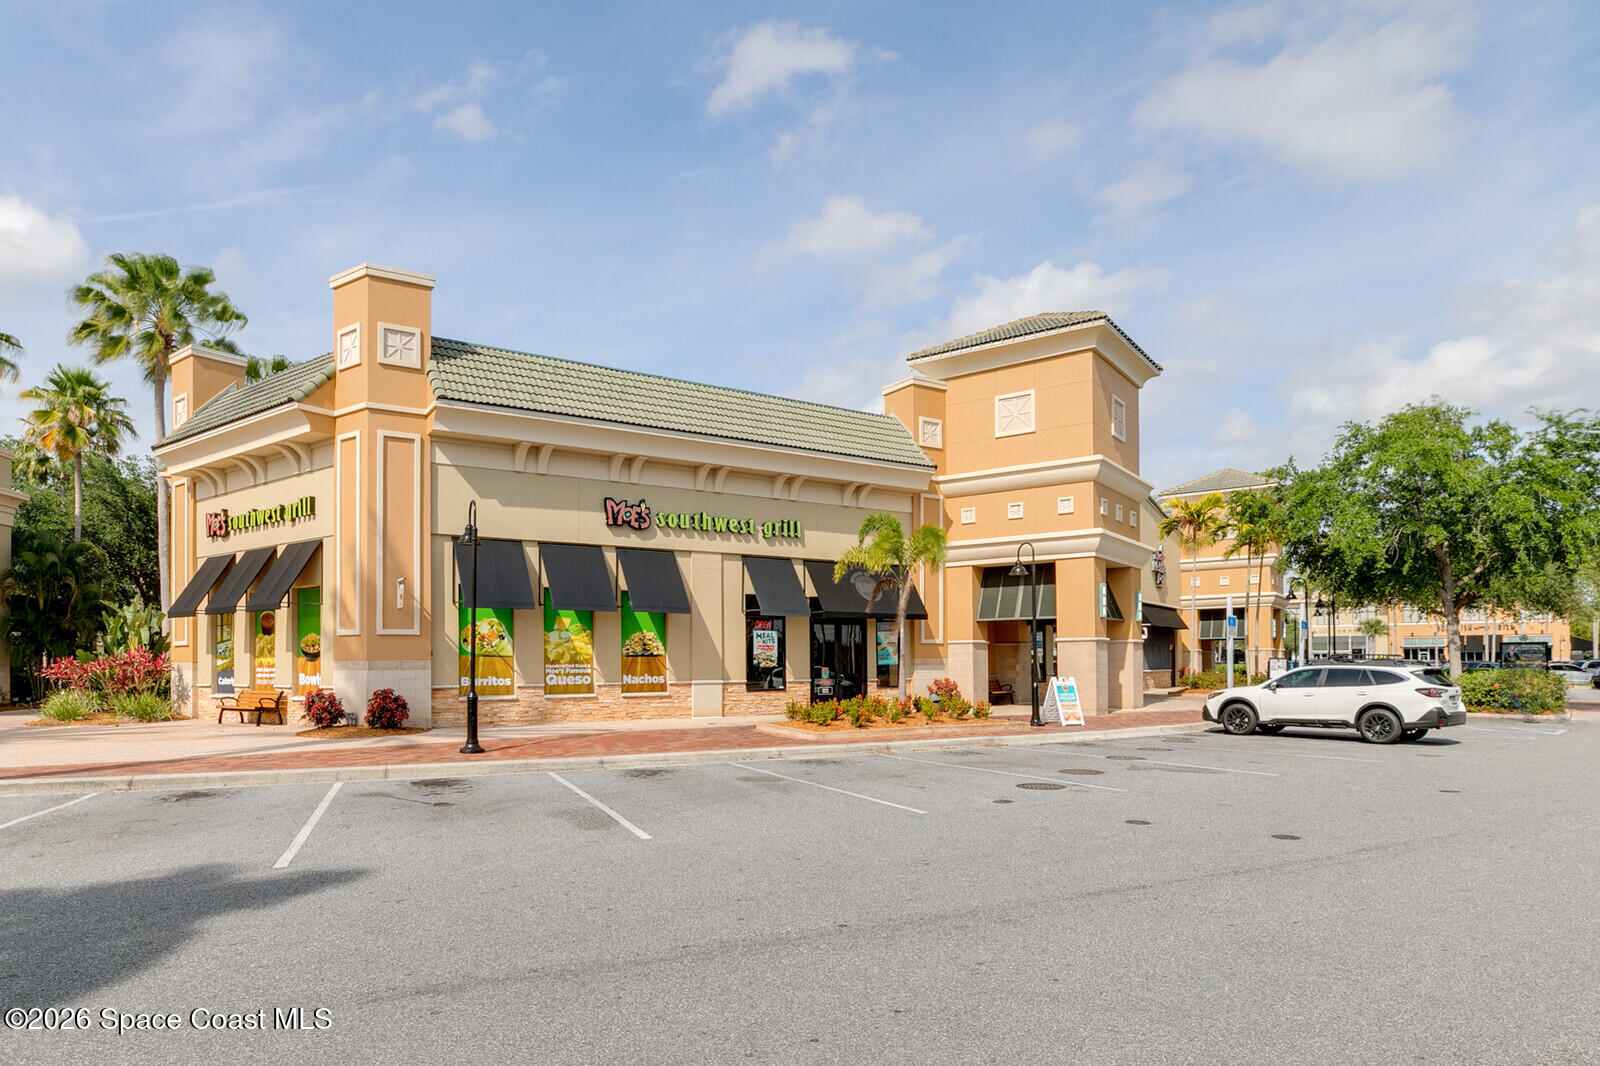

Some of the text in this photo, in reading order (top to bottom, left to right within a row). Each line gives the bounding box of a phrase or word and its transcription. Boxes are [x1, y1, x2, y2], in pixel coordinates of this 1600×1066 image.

[228, 504, 284, 531] southwest
[285, 496, 315, 521] grill
[656, 512, 755, 535] southwest
[762, 520, 801, 538] grill
[545, 674, 592, 686] Queso
[622, 673, 665, 684] Nachos
